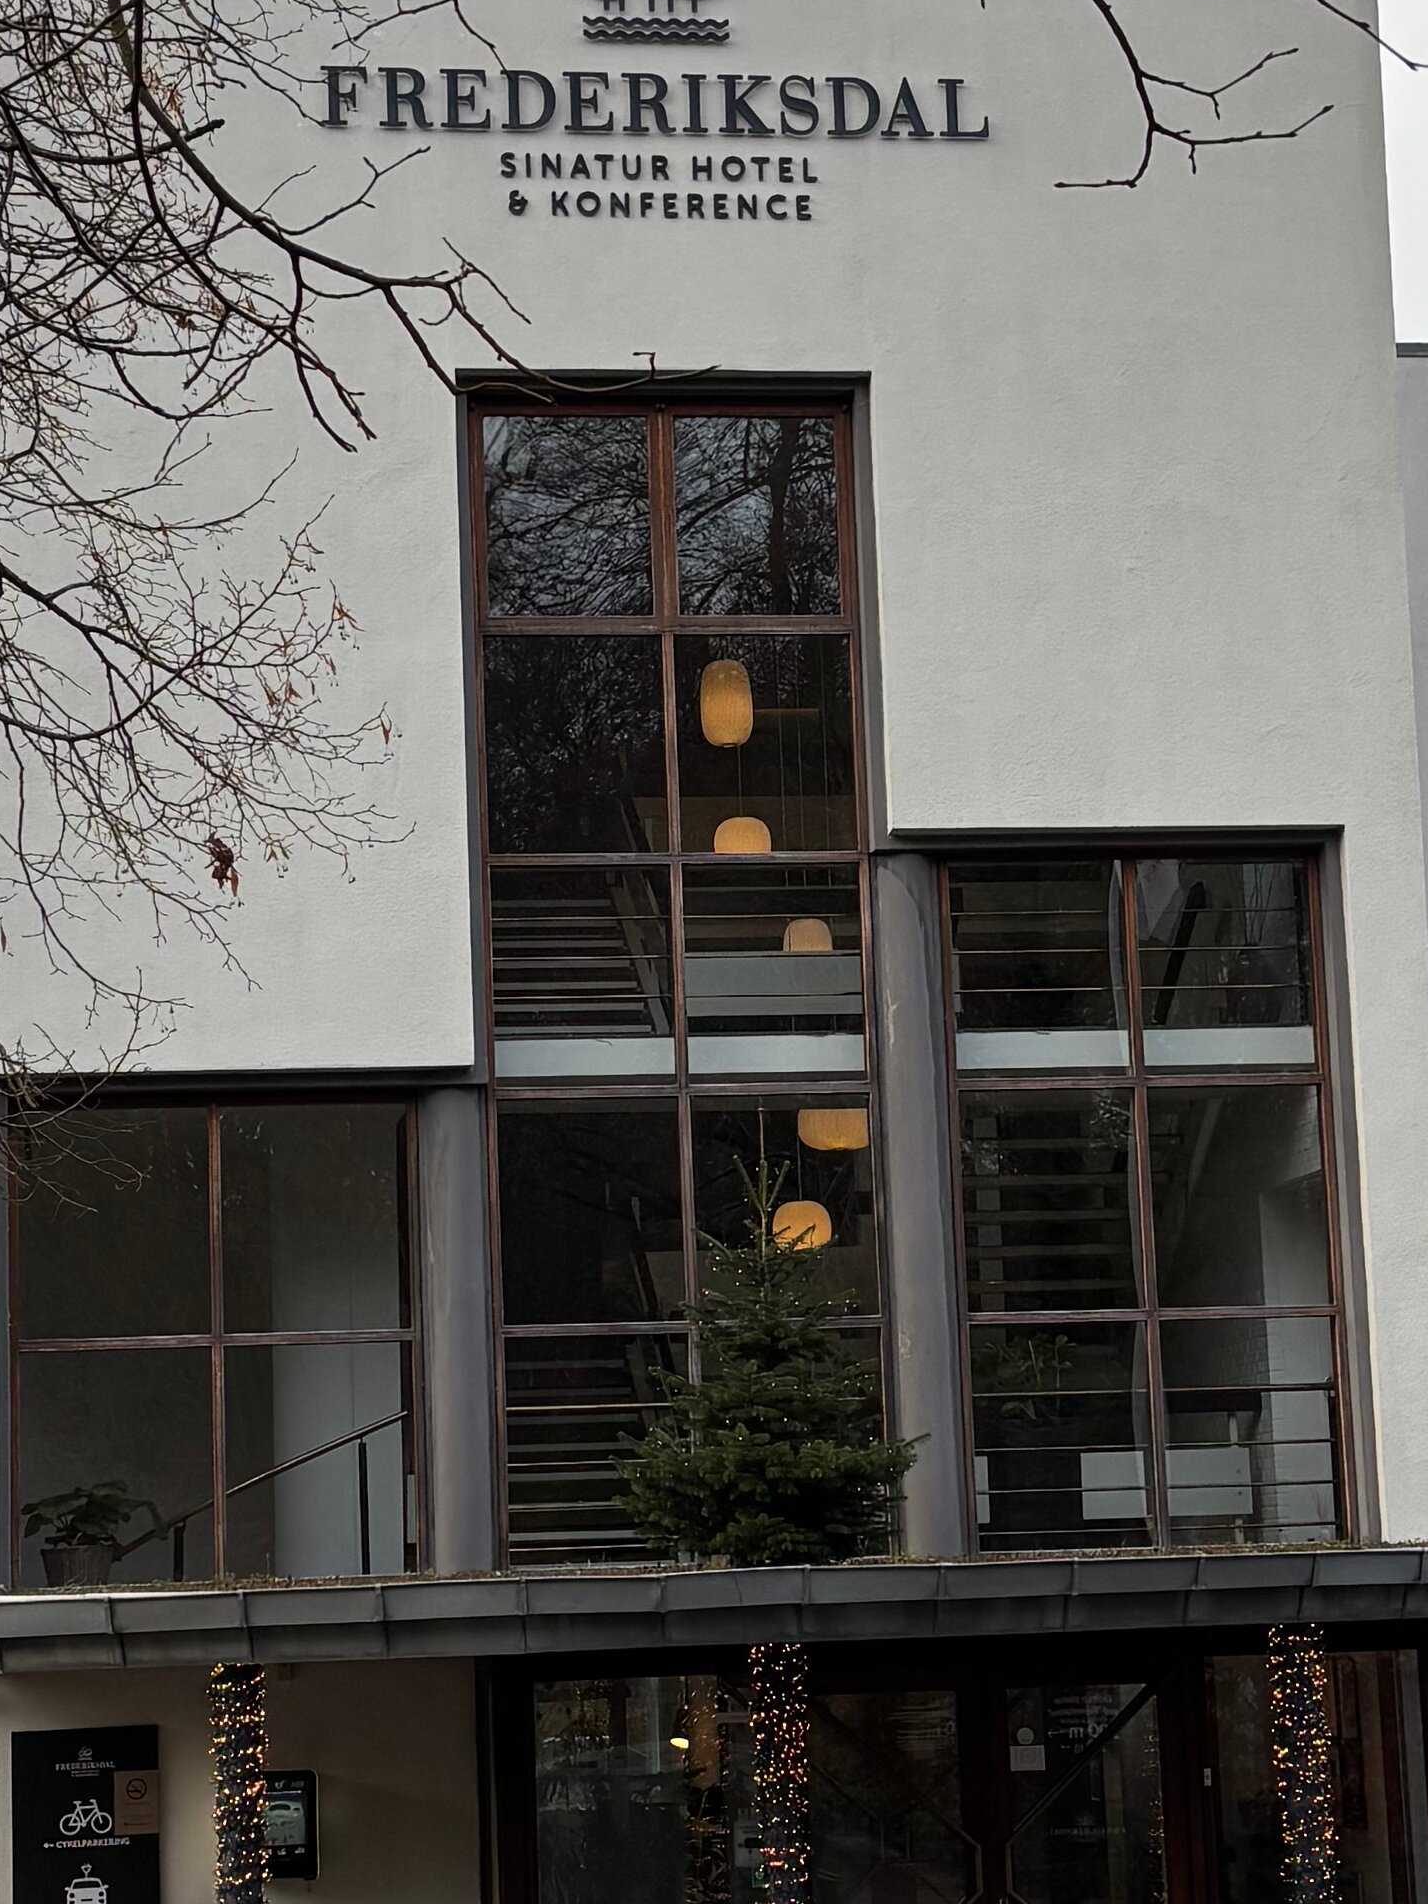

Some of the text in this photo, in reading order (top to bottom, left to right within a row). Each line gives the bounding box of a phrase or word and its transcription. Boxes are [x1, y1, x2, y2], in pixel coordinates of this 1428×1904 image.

[319, 65, 990, 139] FREDERIKSDAL
[499, 151, 819, 184] SINATUR HOTEL
[508, 189, 813, 222] & KONFERENCE
